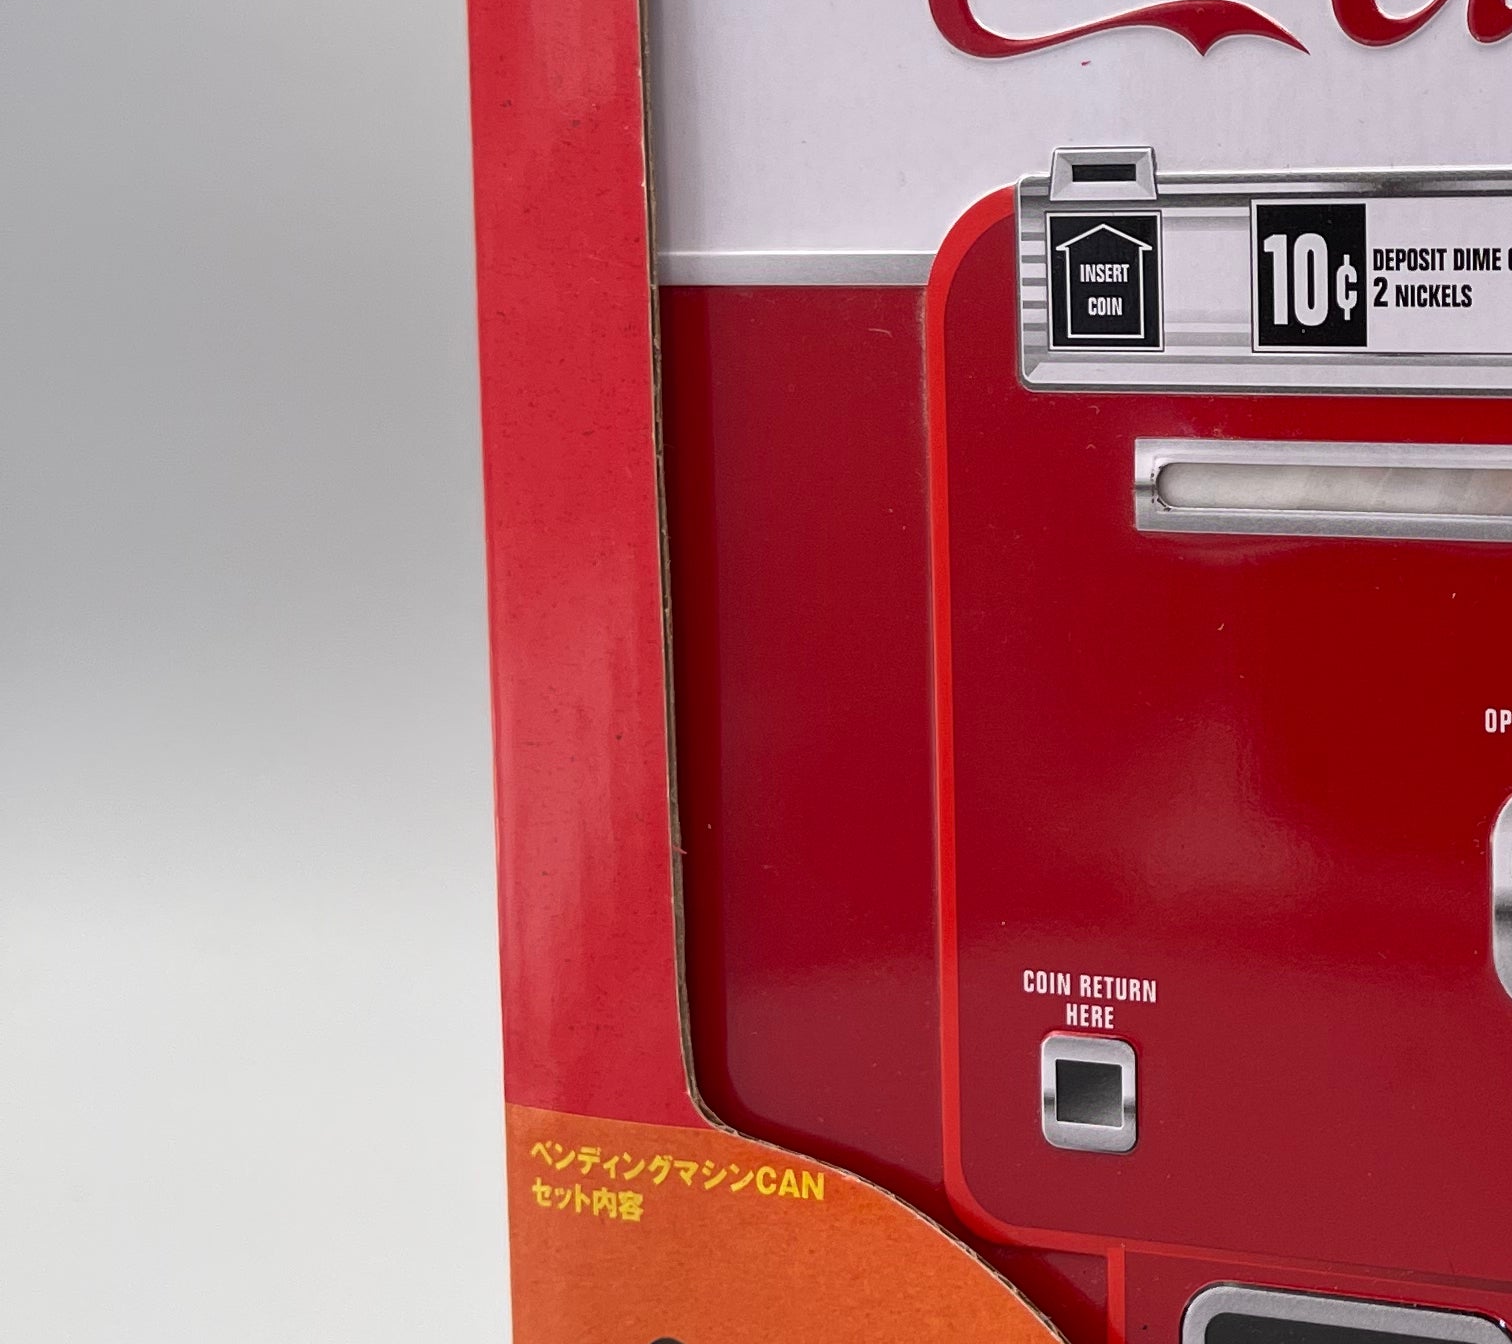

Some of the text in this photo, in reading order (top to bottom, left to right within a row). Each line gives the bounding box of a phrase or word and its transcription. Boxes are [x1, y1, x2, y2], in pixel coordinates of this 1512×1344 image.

[1079, 263, 1130, 285] INSERT
[1373, 247, 1449, 272] DEPOSIT
[1453, 247, 1502, 272] DIME
[1088, 297, 1123, 317] COIN
[1373, 277, 1473, 309] 2 NICKELS
[1023, 969, 1157, 1003] COIN RETURN
[1066, 1003, 1114, 1029] HERE
[531, 1140, 825, 1201] ベンディングマシンCAN
[531, 1177, 645, 1222] セット内容
